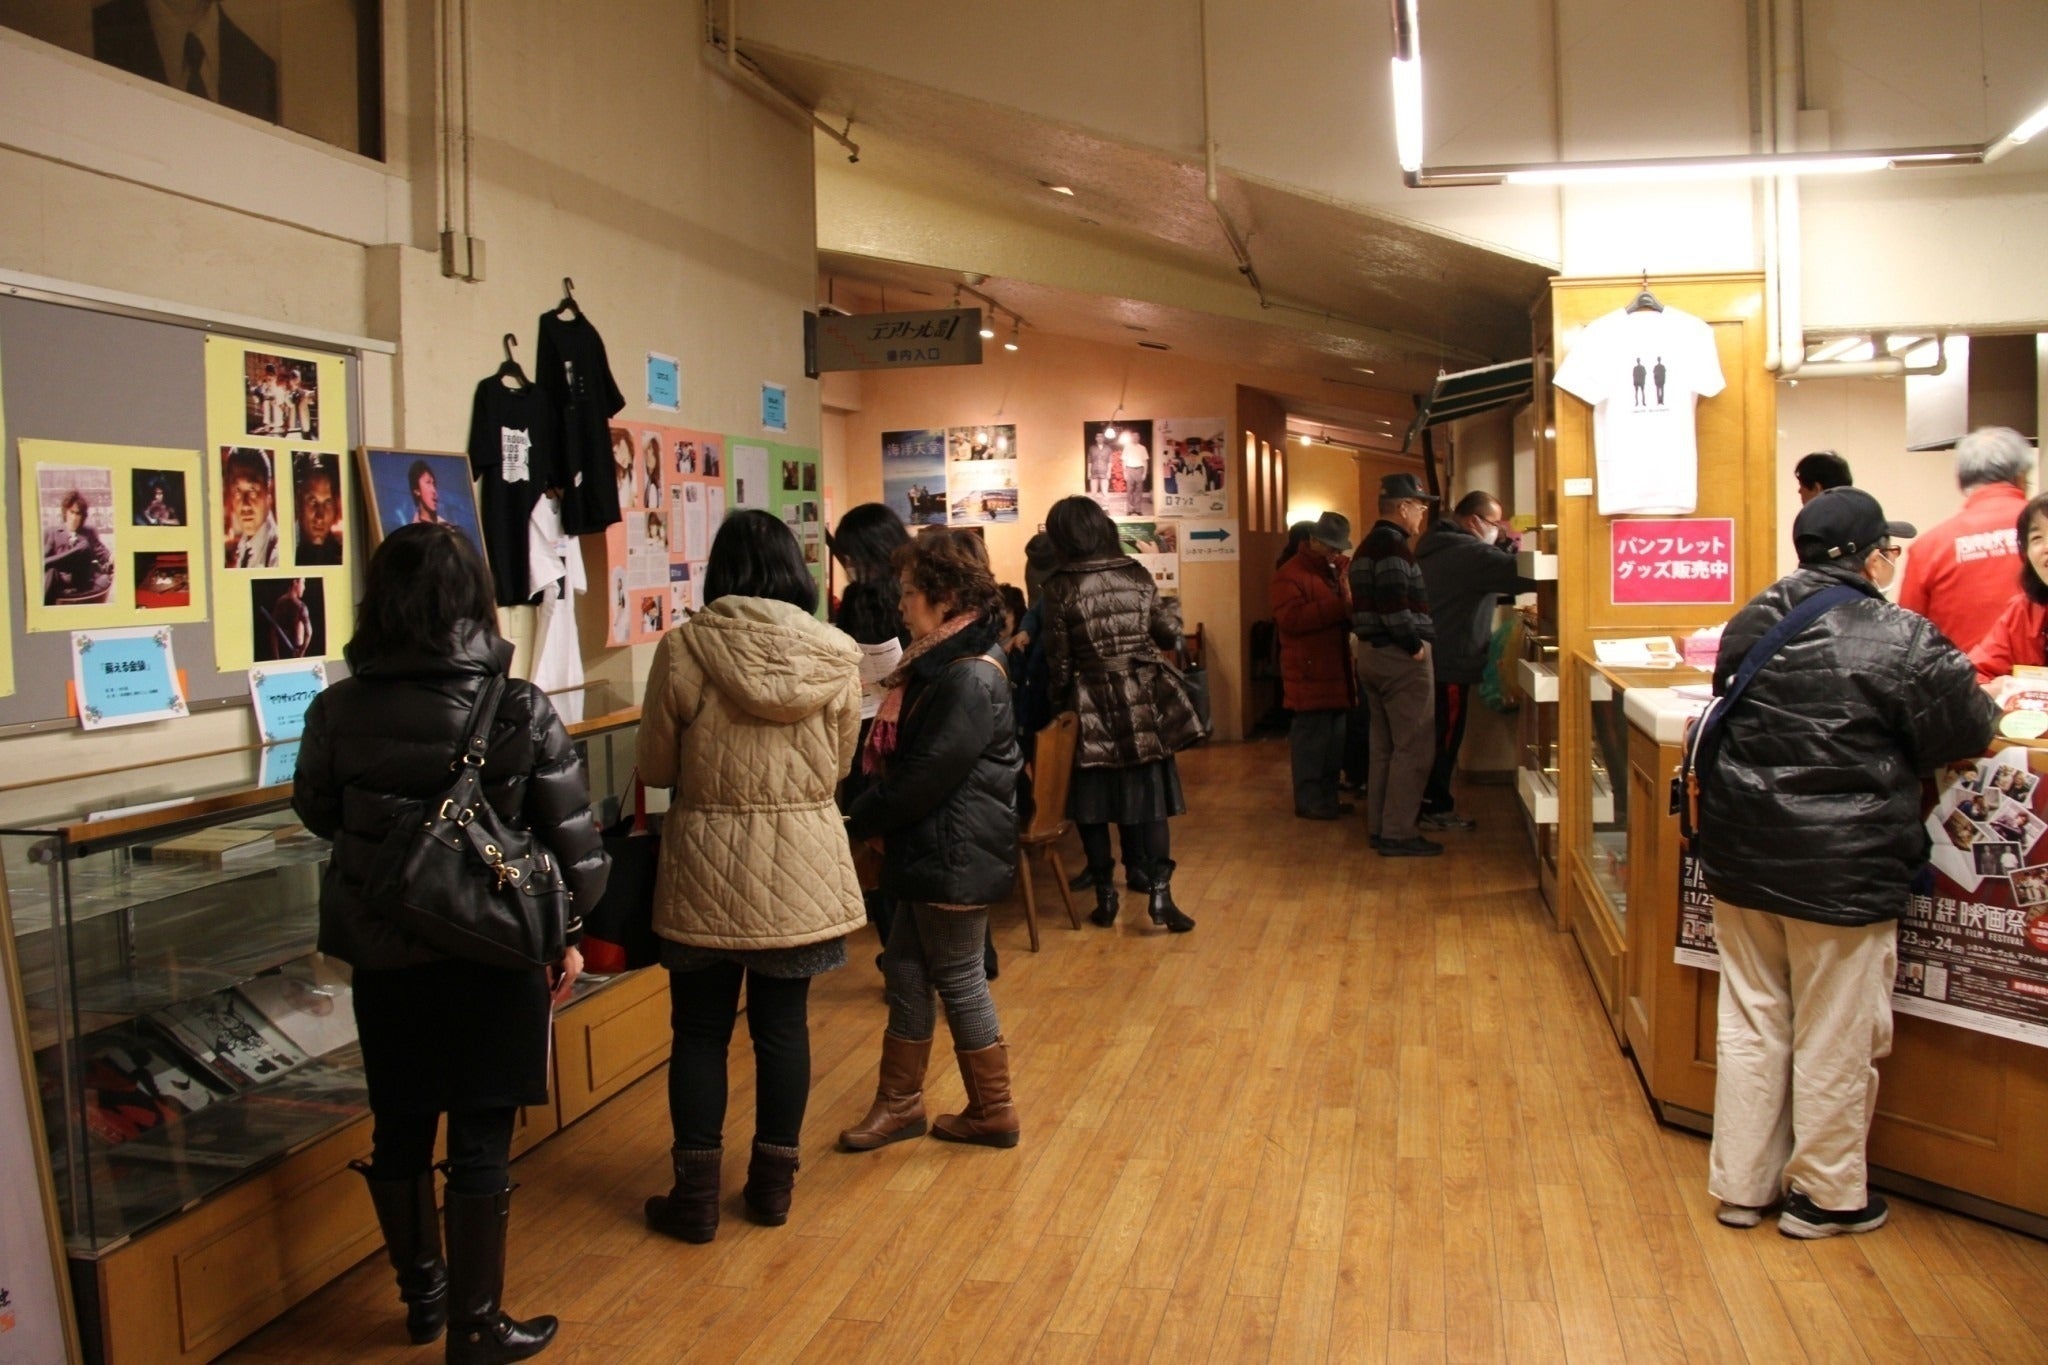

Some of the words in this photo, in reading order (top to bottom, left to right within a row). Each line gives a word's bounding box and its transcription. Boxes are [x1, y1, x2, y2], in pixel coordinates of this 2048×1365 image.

[1618, 536, 1726, 555] パンフレット
[1617, 559, 1729, 579] グッズ販売中
[1965, 928, 1984, 939] FILM
[1989, 933, 2025, 947] FESTIVAL
